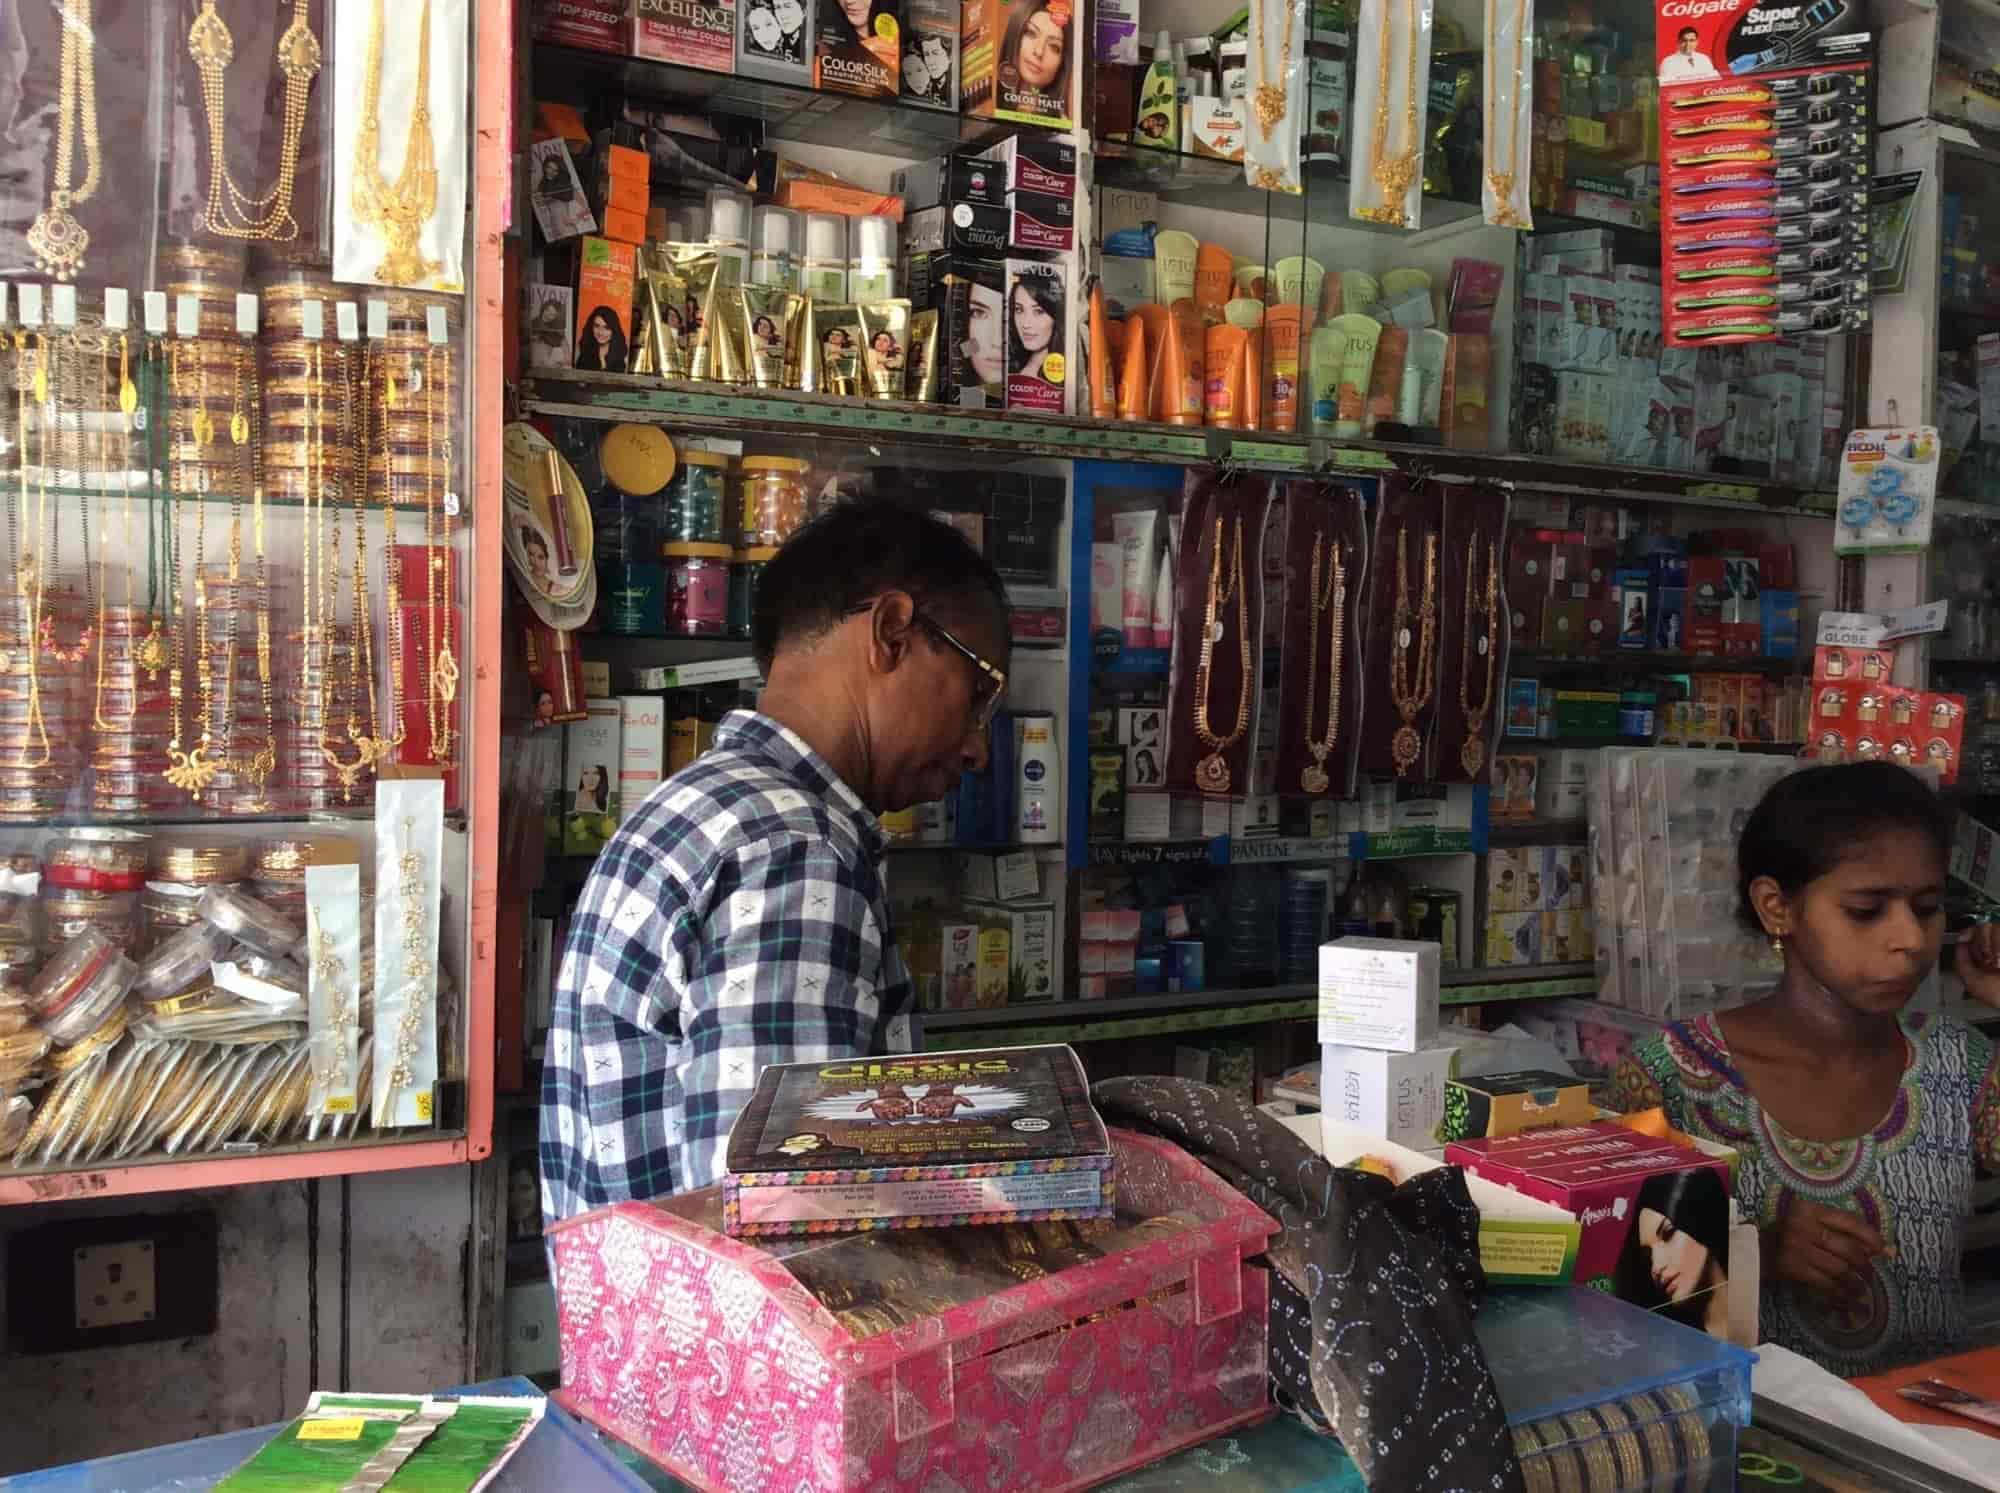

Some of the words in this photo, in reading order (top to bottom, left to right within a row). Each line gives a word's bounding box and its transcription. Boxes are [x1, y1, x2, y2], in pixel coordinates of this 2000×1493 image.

[639, 0, 734, 27] EXCELLENCE
[1661, 0, 1740, 18] Colgate
[580, 8, 619, 24] SPEED
[1746, 6, 1801, 26] Super
[821, 56, 890, 79] COLORSILK
[1003, 92, 1036, 105] COLOR
[1704, 172, 1750, 183] Colgate
[1704, 200, 1751, 211] Colgate
[1705, 230, 1751, 241] Colgate
[1706, 259, 1752, 270] Colgate
[1706, 288, 1753, 298] Colgate
[1707, 316, 1753, 327] Colgate
[1824, 632, 1869, 644] GLOBE
[1231, 842, 1292, 860] PANTENE
